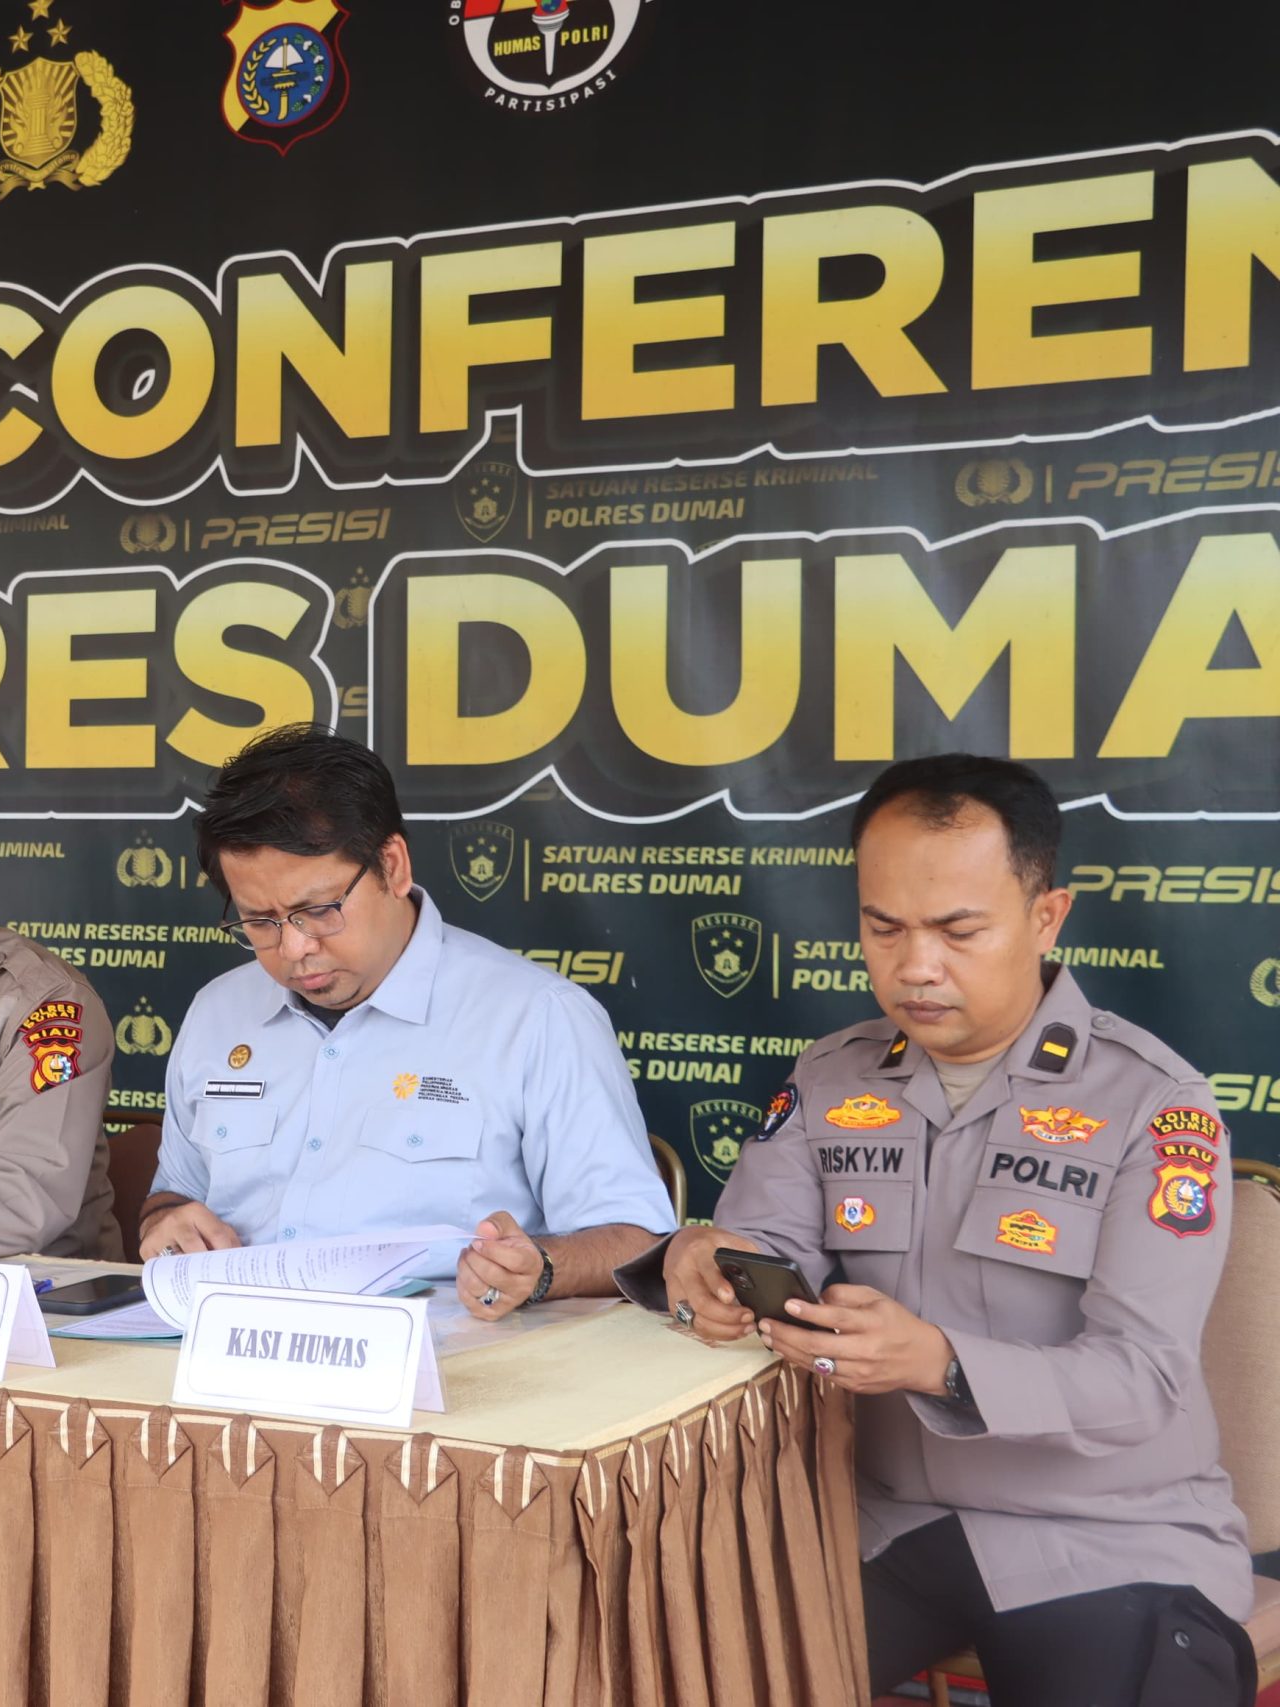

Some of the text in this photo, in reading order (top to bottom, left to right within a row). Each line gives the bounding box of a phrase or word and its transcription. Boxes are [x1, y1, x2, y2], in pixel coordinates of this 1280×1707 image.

[494, 25, 608, 57] HUMAS POLRI
[484, 69, 616, 112] PARTISIPASI
[546, 463, 879, 500] SATUAN RESERSE KRIMINAL
[1068, 450, 1280, 500] PRESI
[545, 498, 746, 529] POLRES DUMAI
[201, 508, 391, 549] PRESISI
[407, 533, 1280, 767] DUMA
[542, 846, 856, 866] SATUAN RESERSE KRIMINA
[541, 873, 742, 895] POLRES DUMAI
[1069, 865, 1280, 903] PRESI
[84, 923, 169, 942] RESERSE
[90, 948, 166, 969] DUMAI
[1044, 947, 1164, 969] RIMINAL
[792, 969, 874, 991] POLR
[29, 1028, 76, 1042] RIAU
[639, 1032, 745, 1054] RESERSE
[647, 1059, 742, 1084] DUMAI
[1153, 1111, 1216, 1134] POLRES
[1161, 1121, 1216, 1138] DUMAI
[819, 1146, 904, 1174] RISKY.W
[1165, 1145, 1212, 1163] RIAU
[990, 1152, 1099, 1199] POLRI
[226, 1327, 369, 1370] KASI HUMAS
